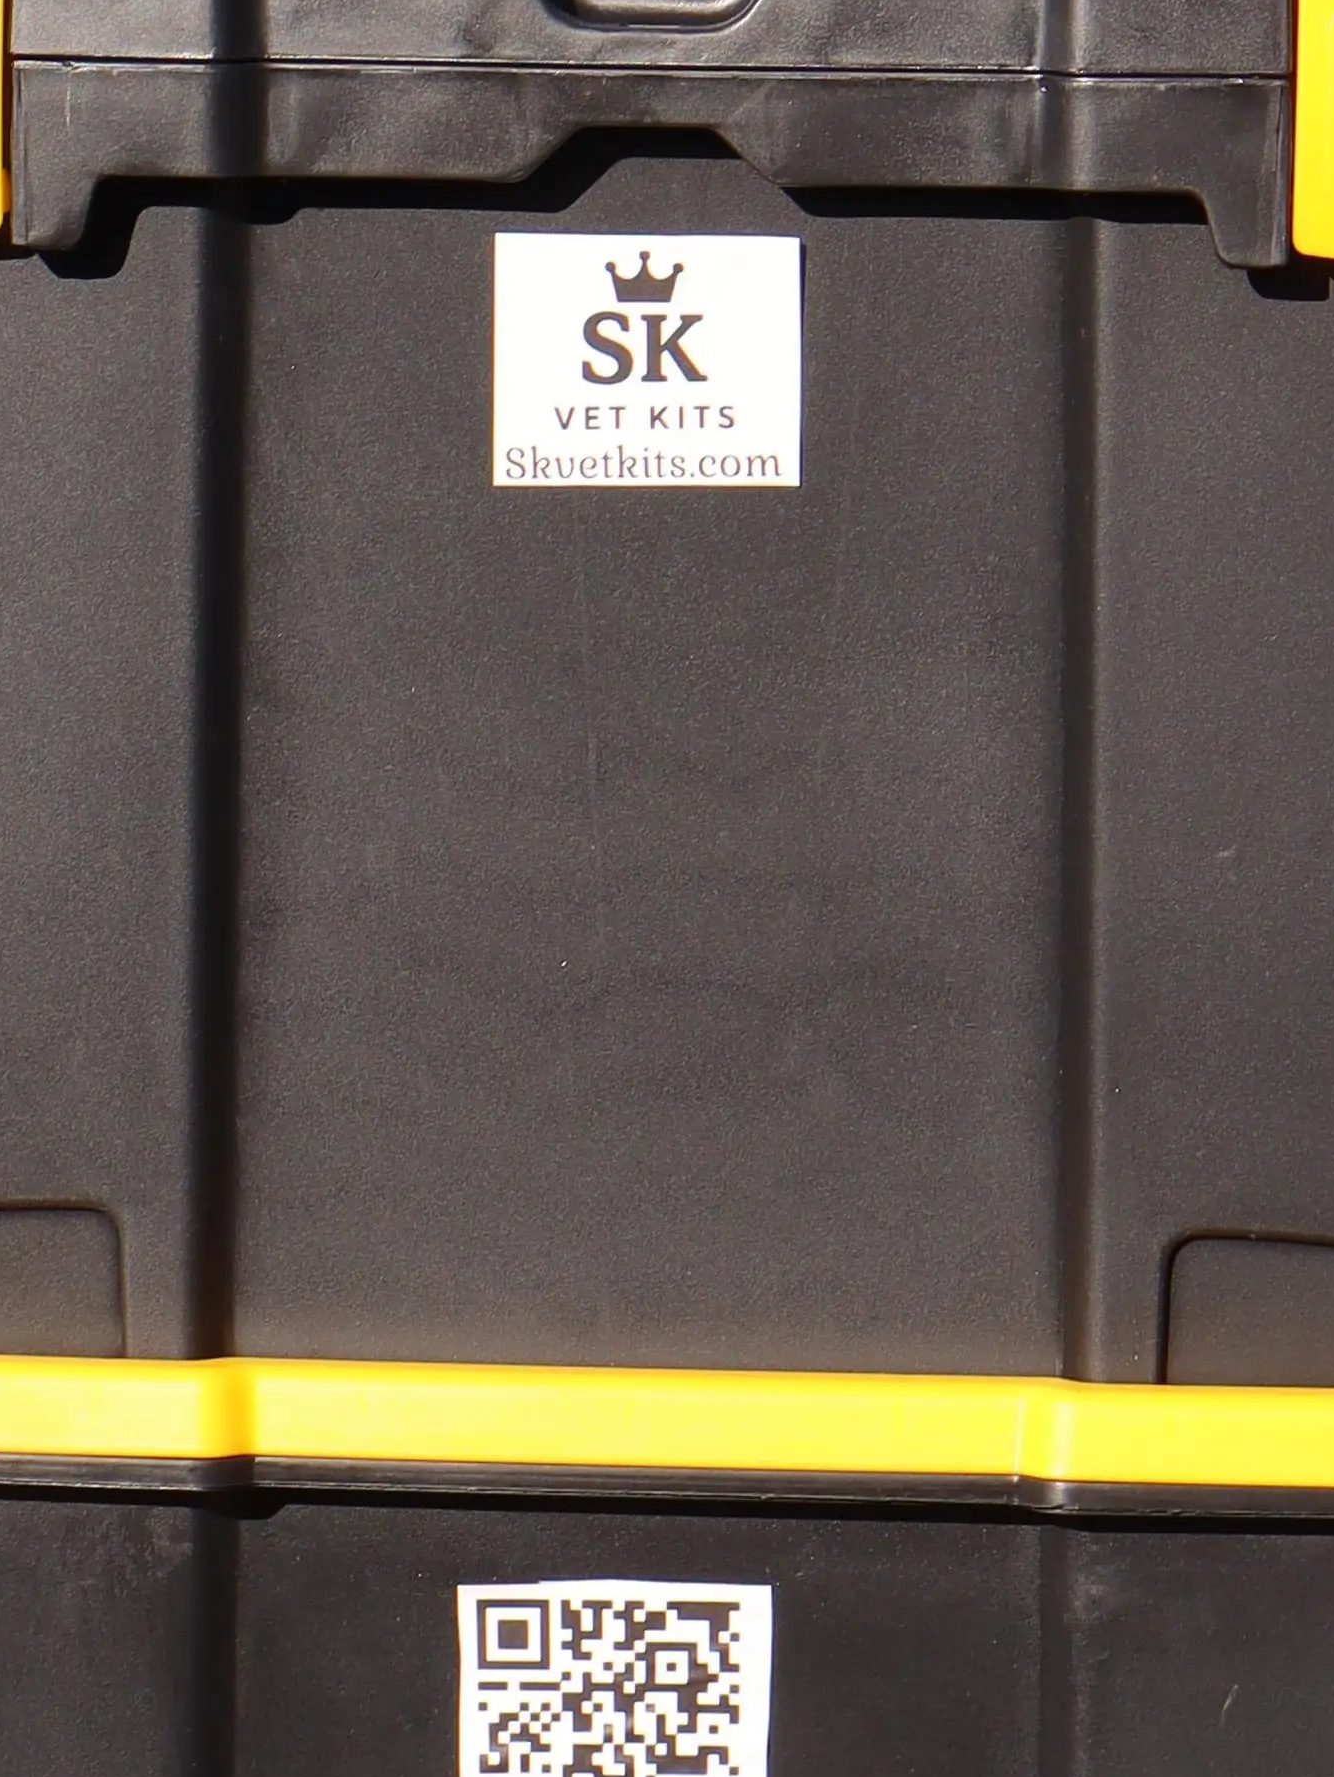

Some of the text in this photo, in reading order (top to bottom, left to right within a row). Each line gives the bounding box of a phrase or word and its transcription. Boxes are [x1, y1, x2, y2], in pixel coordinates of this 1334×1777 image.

[582, 311, 708, 385] SK
[554, 405, 736, 430] VET KITS
[505, 444, 782, 480] Skvetkits.com
